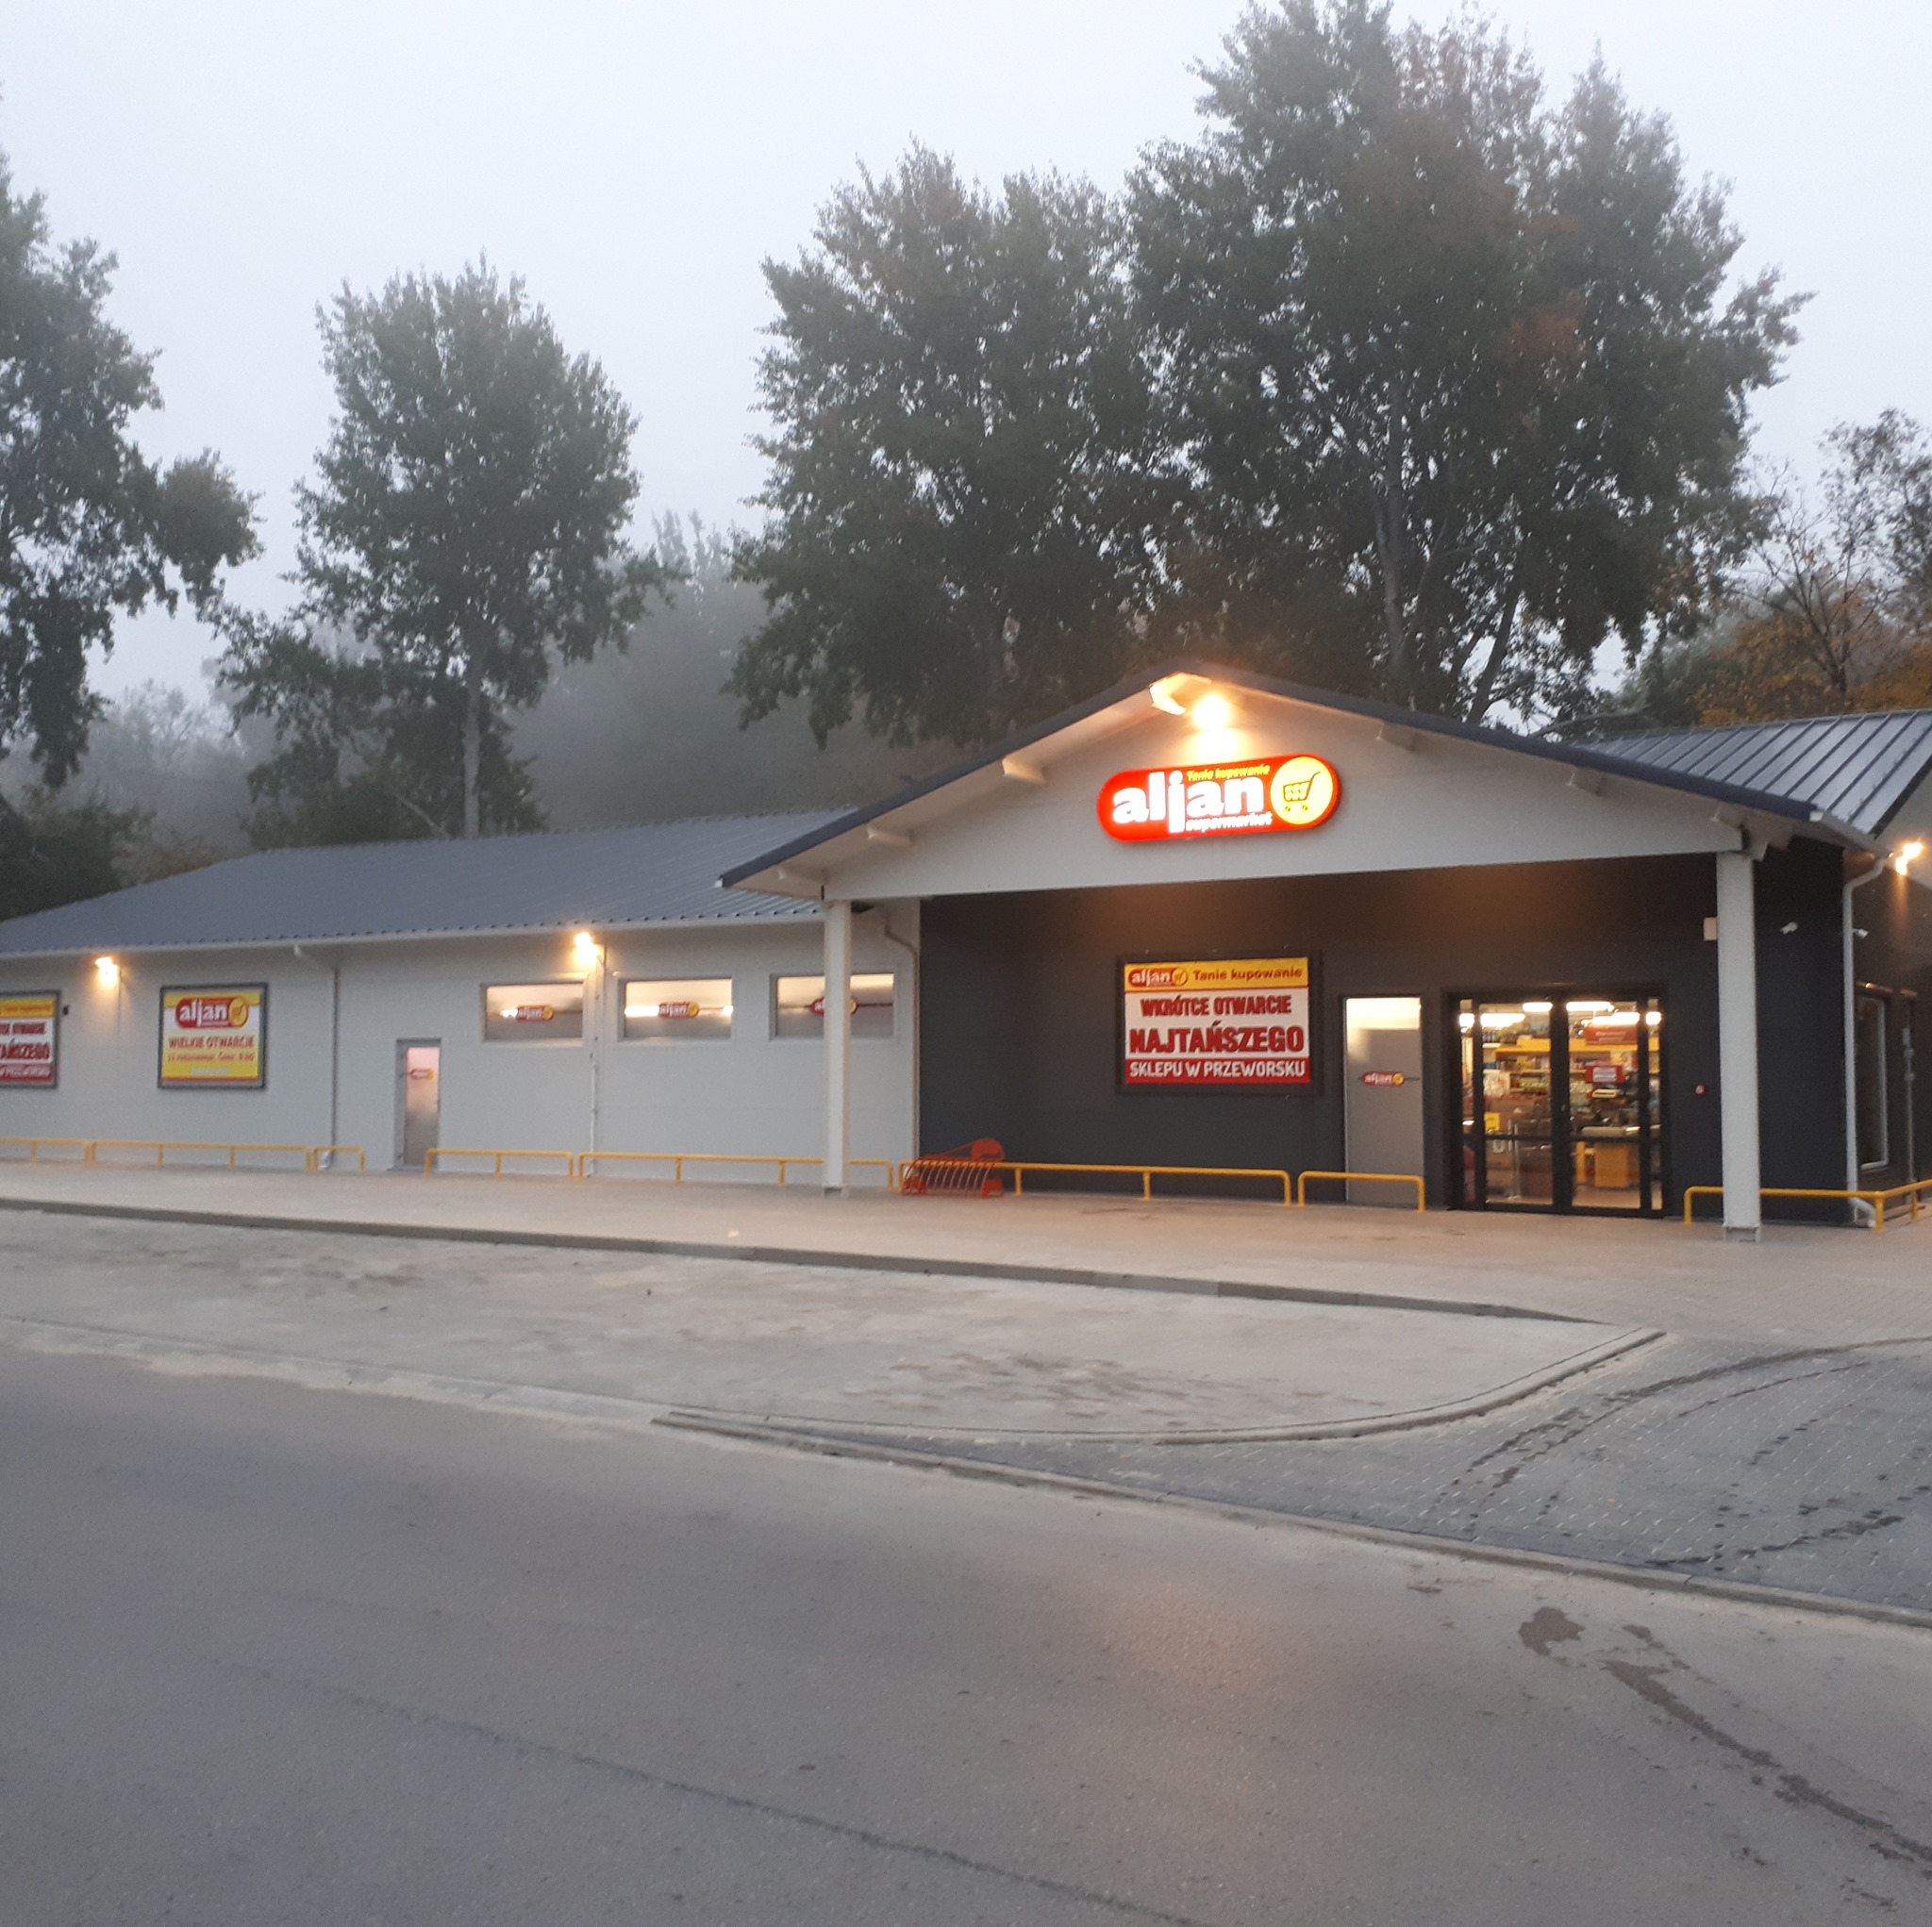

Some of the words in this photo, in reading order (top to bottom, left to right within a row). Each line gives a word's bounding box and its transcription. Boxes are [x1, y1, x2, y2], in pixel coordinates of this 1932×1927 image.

[1111, 770, 1264, 833] aljan
[1186, 811, 1273, 832] supermarket
[1131, 969, 1171, 986] aljan
[1192, 969, 1226, 981] Tanie
[1231, 966, 1303, 982] kupowanie
[179, 999, 227, 1026] aljan
[1140, 994, 1210, 1017] WKRÓTCE
[1213, 995, 1291, 1016] OTWARCIE
[1129, 1021, 1305, 1054] NAJTAŃSZEGO
[1129, 1062, 1181, 1077] SKLEPU
[1185, 1062, 1201, 1077] W
[1204, 1060, 1306, 1077] PRZEWORSKU
